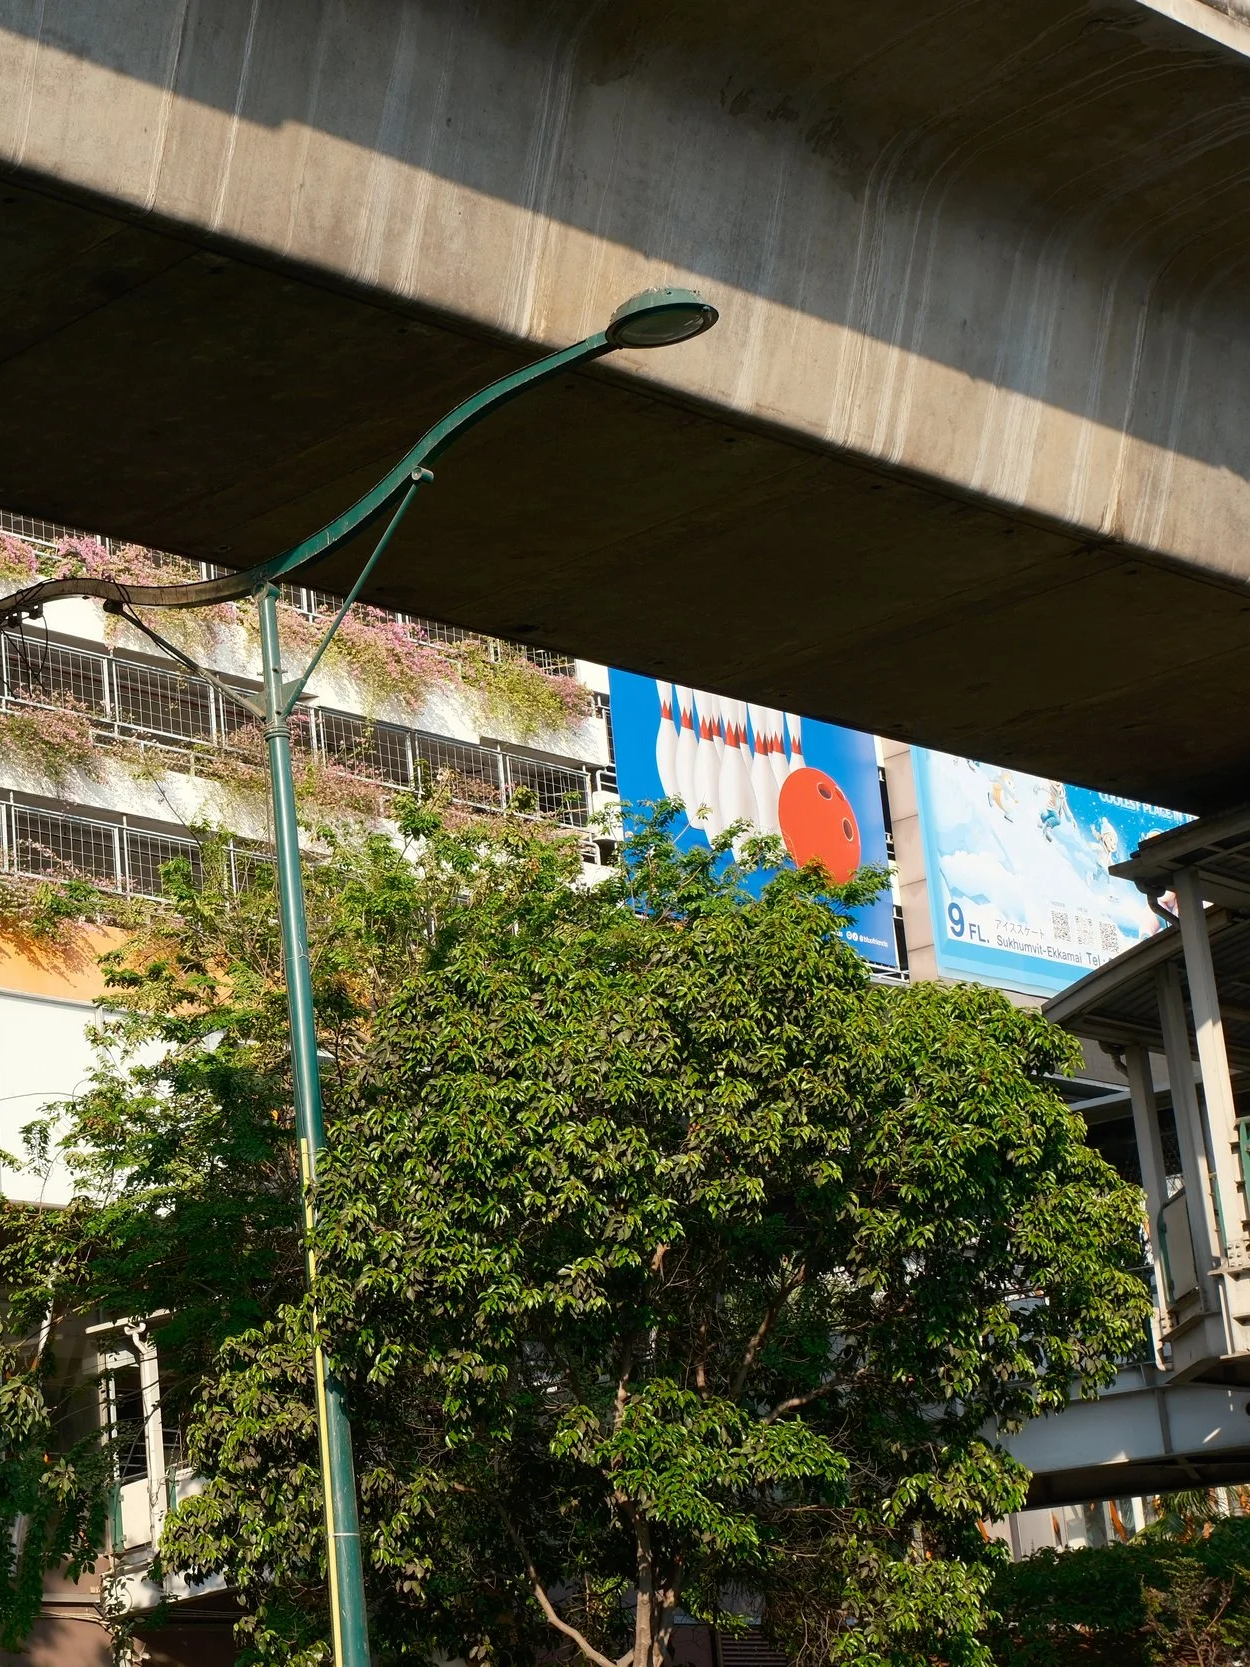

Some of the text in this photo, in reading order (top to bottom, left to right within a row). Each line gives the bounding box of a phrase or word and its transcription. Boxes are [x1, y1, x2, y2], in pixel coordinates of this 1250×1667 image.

[948, 902, 990, 943] 9 FL.
[995, 919, 1045, 939] アイススケート
[997, 934, 1083, 964] Sukhumvit-Ekkamai
